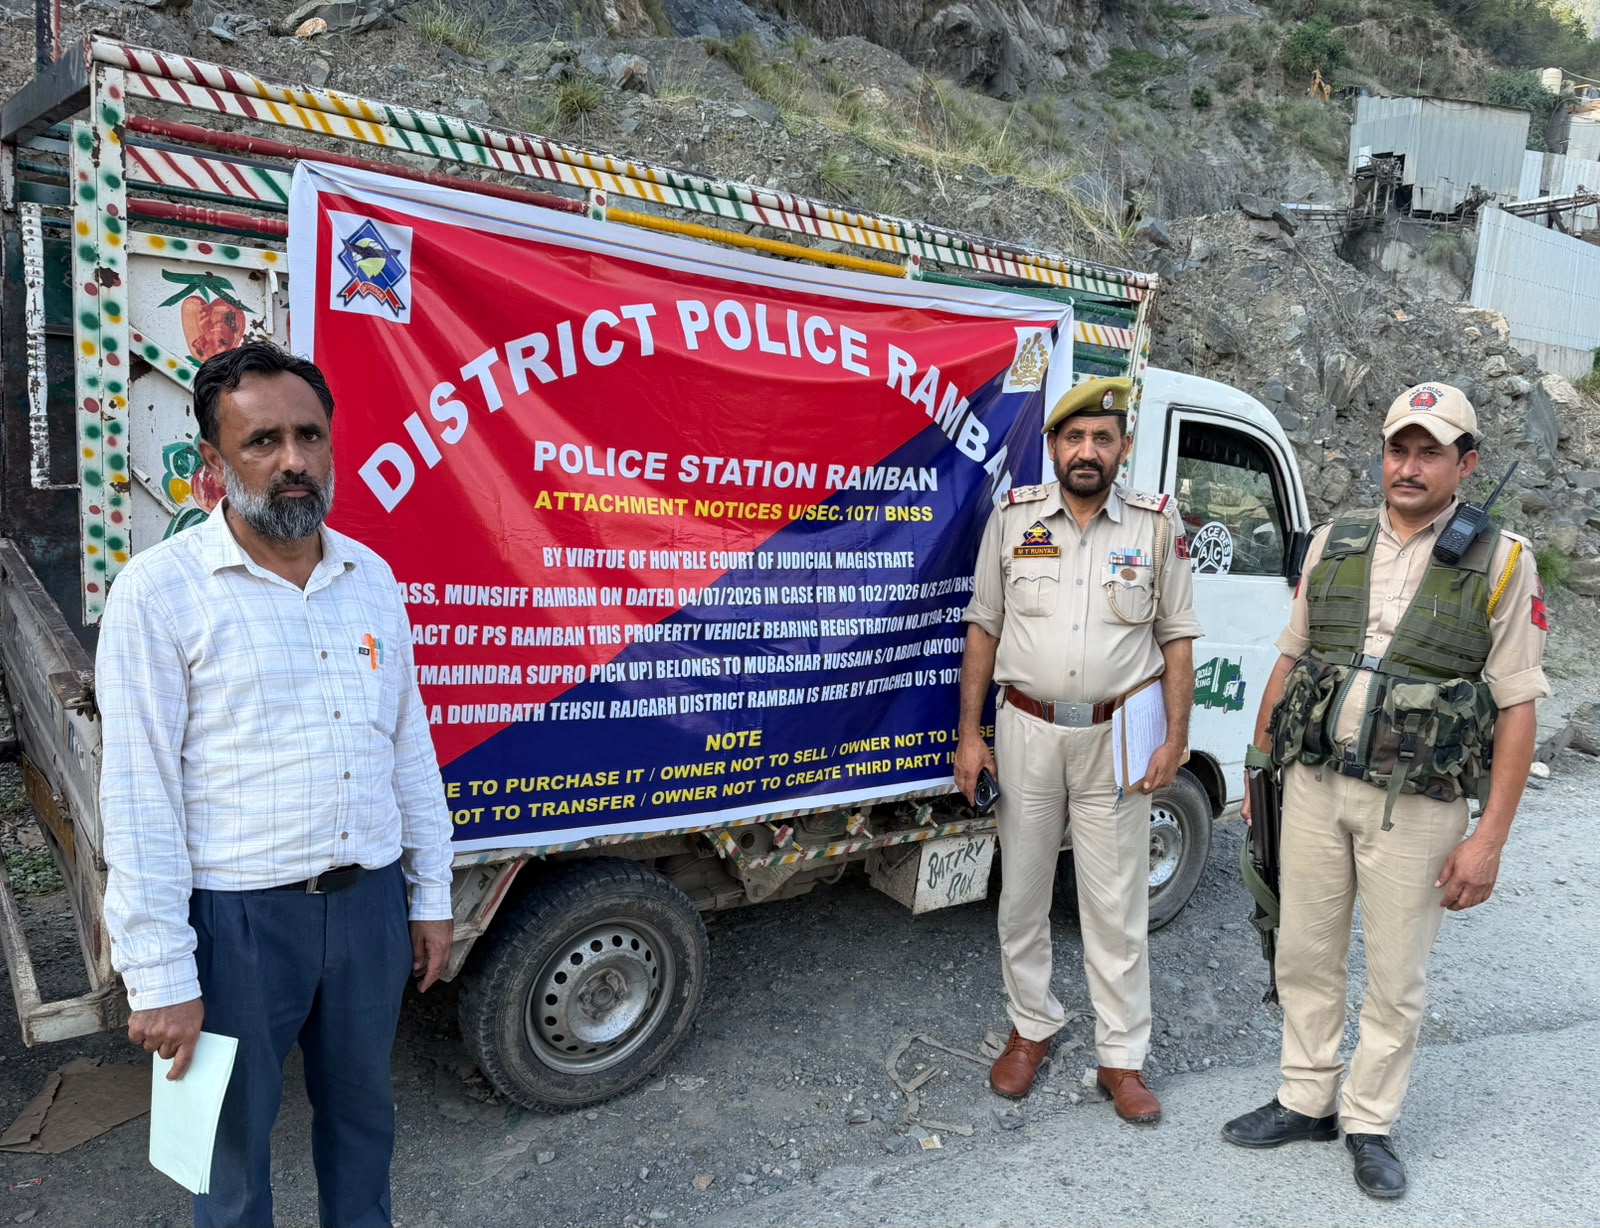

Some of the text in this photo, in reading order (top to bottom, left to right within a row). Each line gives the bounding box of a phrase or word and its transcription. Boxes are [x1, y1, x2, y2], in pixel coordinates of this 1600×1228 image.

[358, 303, 656, 513] DISTRICT
[676, 300, 870, 376] POLICE
[534, 440, 938, 491] POLICE STATION RAMBAN
[534, 490, 688, 516] ATTACHMENT
[694, 500, 782, 520] NOTICES
[884, 506, 933, 521] BNSS
[543, 547, 915, 570] BY VIRTUE OF HON'BLE COURT OF JUDICIAL MAGISTRATE
[445, 584, 529, 607] MUNSIFF
[532, 587, 597, 608] RAMBAN
[600, 587, 622, 607] ON
[626, 588, 674, 607] DATED
[679, 586, 761, 607] 04/07/2026
[765, 586, 778, 605] IN
[783, 586, 813, 604] CASE
[816, 585, 836, 603] FIR
[839, 585, 855, 603] NO
[859, 584, 919, 602] 102/2026
[920, 581, 937, 598] U/S
[412, 624, 450, 645] ACT
[454, 625, 478, 645] OF
[482, 625, 506, 646] PS
[511, 626, 585, 646] RAMBAN
[588, 625, 621, 645] THIS
[625, 623, 700, 643] PROPERTY
[704, 622, 760, 641] VEHICLE
[763, 620, 818, 639] BEARING
[821, 616, 905, 637] REGISTRATION
[526, 665, 586, 684] SUPRO
[589, 663, 625, 683] PICK
[656, 658, 720, 678] BELONGS
[723, 657, 741, 676] TO
[744, 653, 821, 675] MUBASHAR
[824, 650, 873, 670] HUSSAIN
[875, 648, 893, 664] S/O
[895, 641, 922, 661] ABDUL
[447, 703, 545, 724] DUNDRATH
[550, 702, 606, 721] TEHSIL
[610, 698, 676, 718] RAJGARH
[679, 692, 745, 714] DISTRICT
[748, 689, 805, 708] RAMBAN
[806, 687, 819, 704] IS
[821, 682, 848, 702] HERE
[850, 680, 866, 698] BY
[866, 676, 913, 695] ATTACHED
[914, 670, 936, 686] U/S
[705, 730, 763, 751] NOTE
[468, 780, 498, 796] TO
[505, 771, 619, 793] PURCHASE
[626, 769, 644, 784] IT
[660, 760, 725, 780] OWNER
[730, 756, 764, 773] NOT
[769, 753, 789, 768] TO
[793, 748, 828, 764] SELL
[839, 736, 890, 755] OWNER
[894, 732, 923, 748] NOT
[928, 730, 947, 744] TO
[491, 804, 521, 821] TO
[528, 794, 636, 818] TRANSFER
[651, 785, 717, 805] OWNER
[722, 780, 754, 797] NOT
[760, 777, 781, 791] TO
[785, 766, 841, 787] CREATE
[845, 760, 891, 777] THIRD
[896, 753, 941, 770] PARTY
